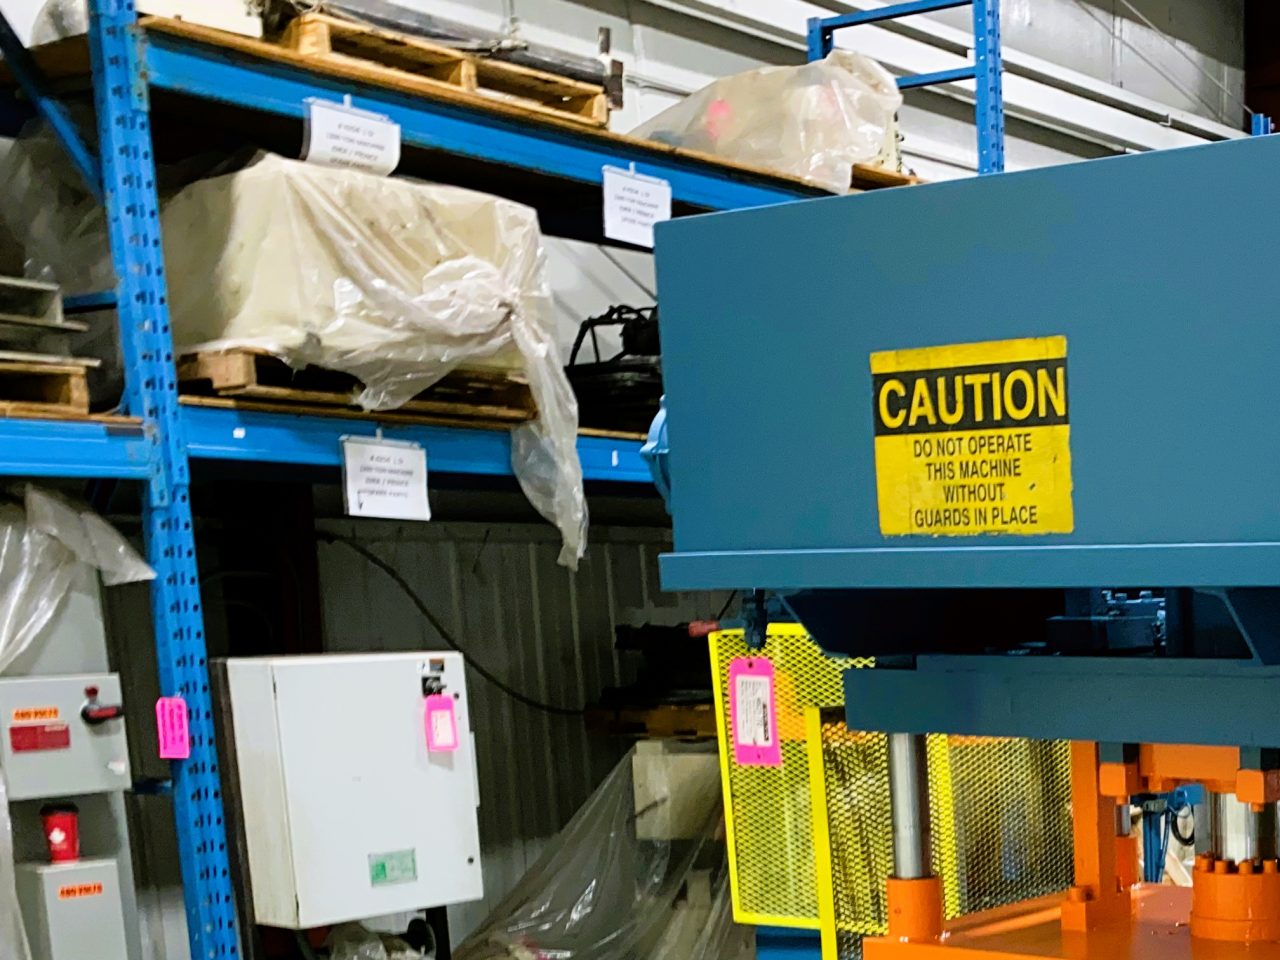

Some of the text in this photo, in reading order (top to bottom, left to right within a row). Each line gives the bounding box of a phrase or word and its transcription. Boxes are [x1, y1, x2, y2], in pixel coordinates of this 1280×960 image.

[879, 367, 1066, 429] CAUTION
[914, 433, 1032, 458] DO NOT OPERATE
[926, 458, 1022, 480] THIS MACHINE
[943, 483, 1005, 503] WITHOUT
[915, 506, 1038, 528] GUARDS IN PLACE
